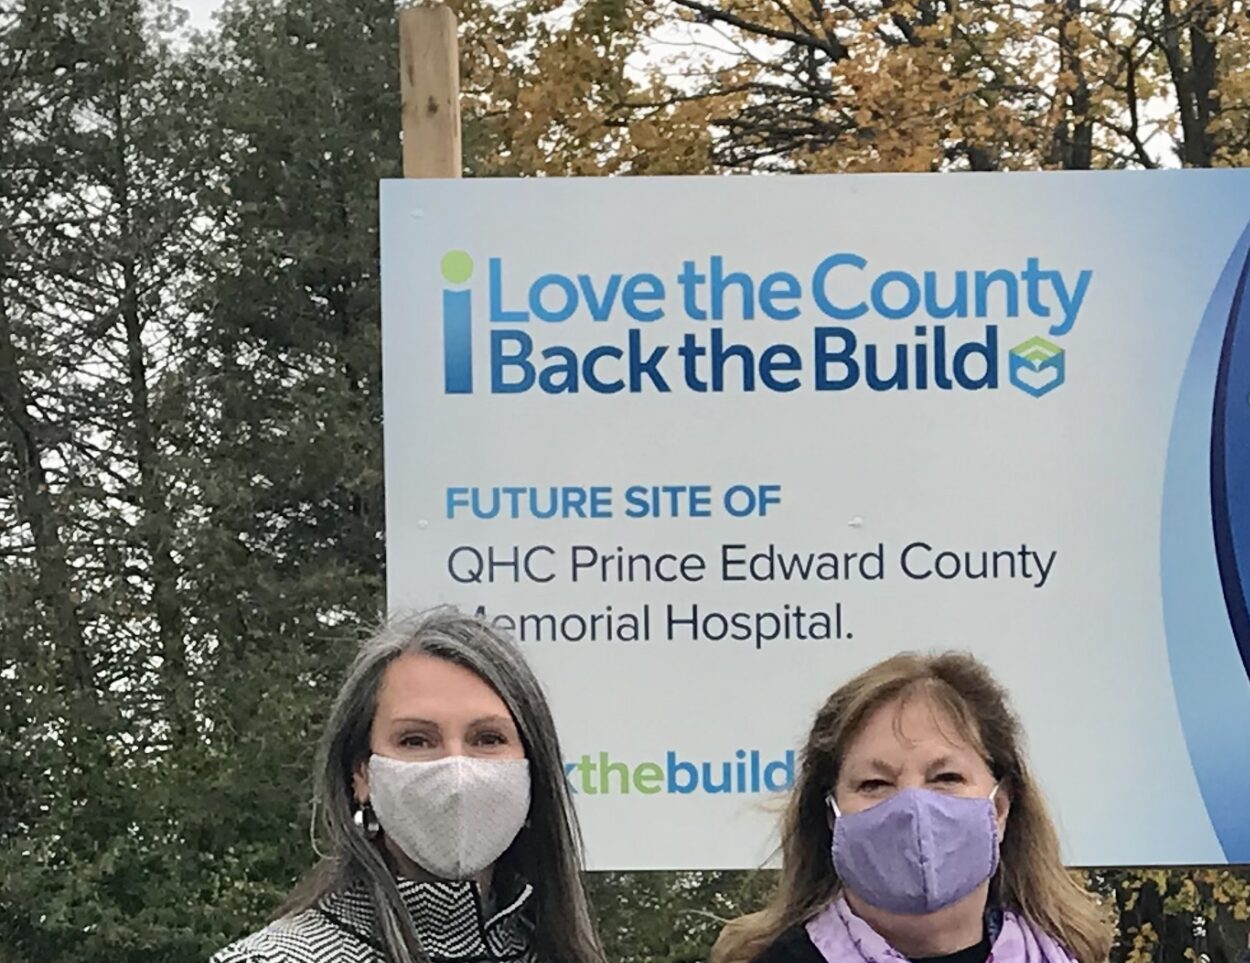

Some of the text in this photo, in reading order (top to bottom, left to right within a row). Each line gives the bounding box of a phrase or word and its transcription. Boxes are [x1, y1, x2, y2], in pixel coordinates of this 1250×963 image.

[488, 257, 666, 323] Love
[677, 255, 800, 320] the
[811, 253, 1093, 336] County
[490, 326, 999, 395] Back the Build
[445, 485, 782, 519] FUTURE SITE OF
[446, 542, 1058, 587] QHC Prince Edward County
[667, 603, 853, 649] Hospital.
